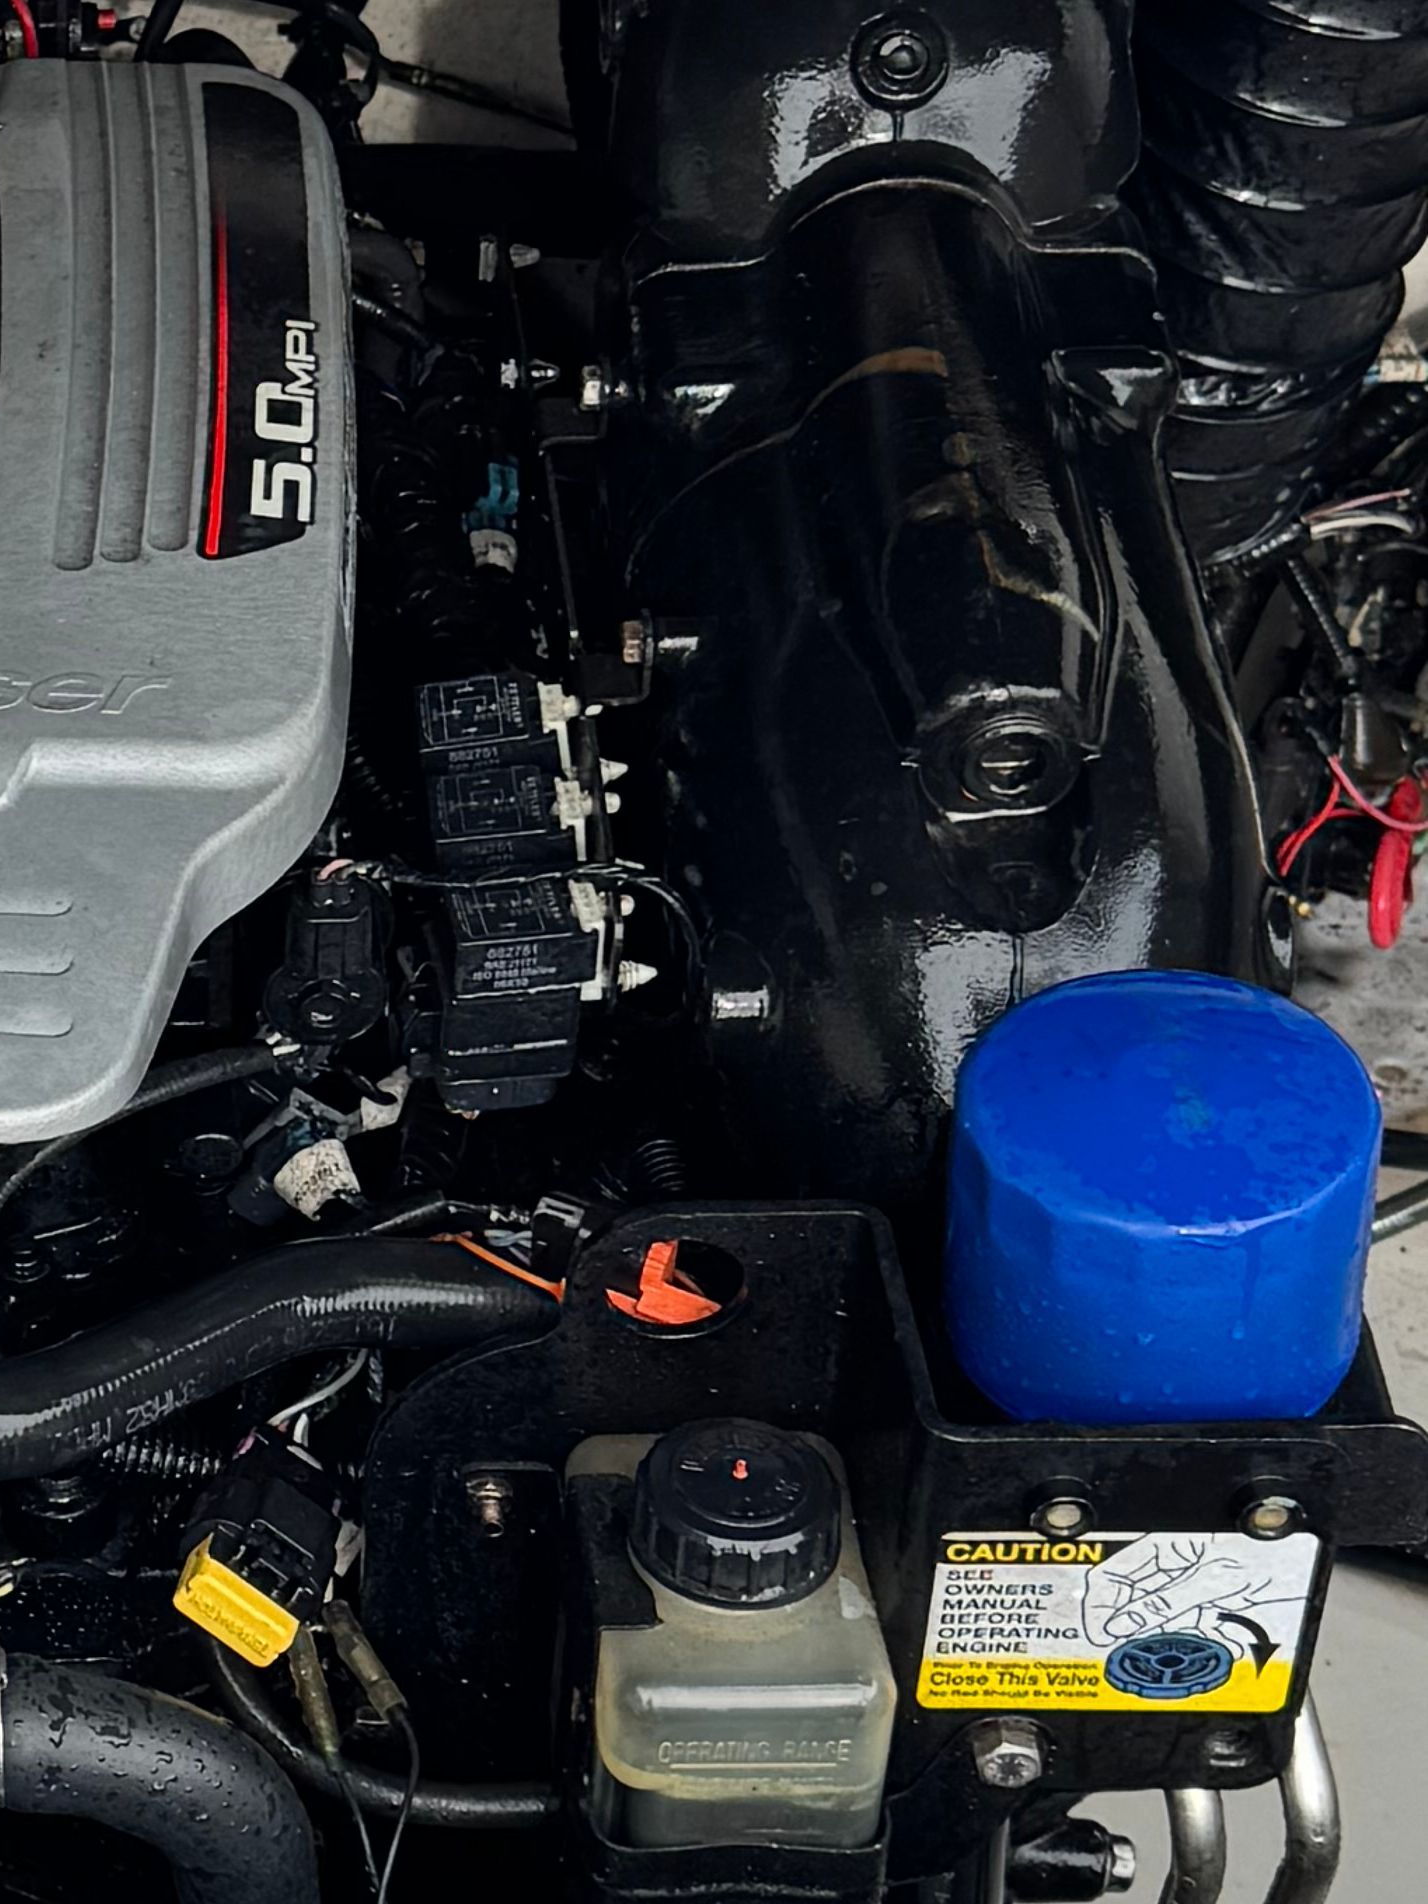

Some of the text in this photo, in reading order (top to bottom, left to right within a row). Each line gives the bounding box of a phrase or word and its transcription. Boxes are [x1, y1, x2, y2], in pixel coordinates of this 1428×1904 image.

[946, 1542, 1103, 1562] CAUTION
[946, 1569, 994, 1581] SEE
[945, 1583, 1055, 1596] OWNERS
[942, 1598, 1048, 1611] MANUAL
[940, 1613, 1040, 1625] BEFORE
[937, 1627, 1080, 1640] OPERATING
[936, 1641, 1028, 1654] ENGINE
[930, 1671, 1100, 1687] Close This Valve
